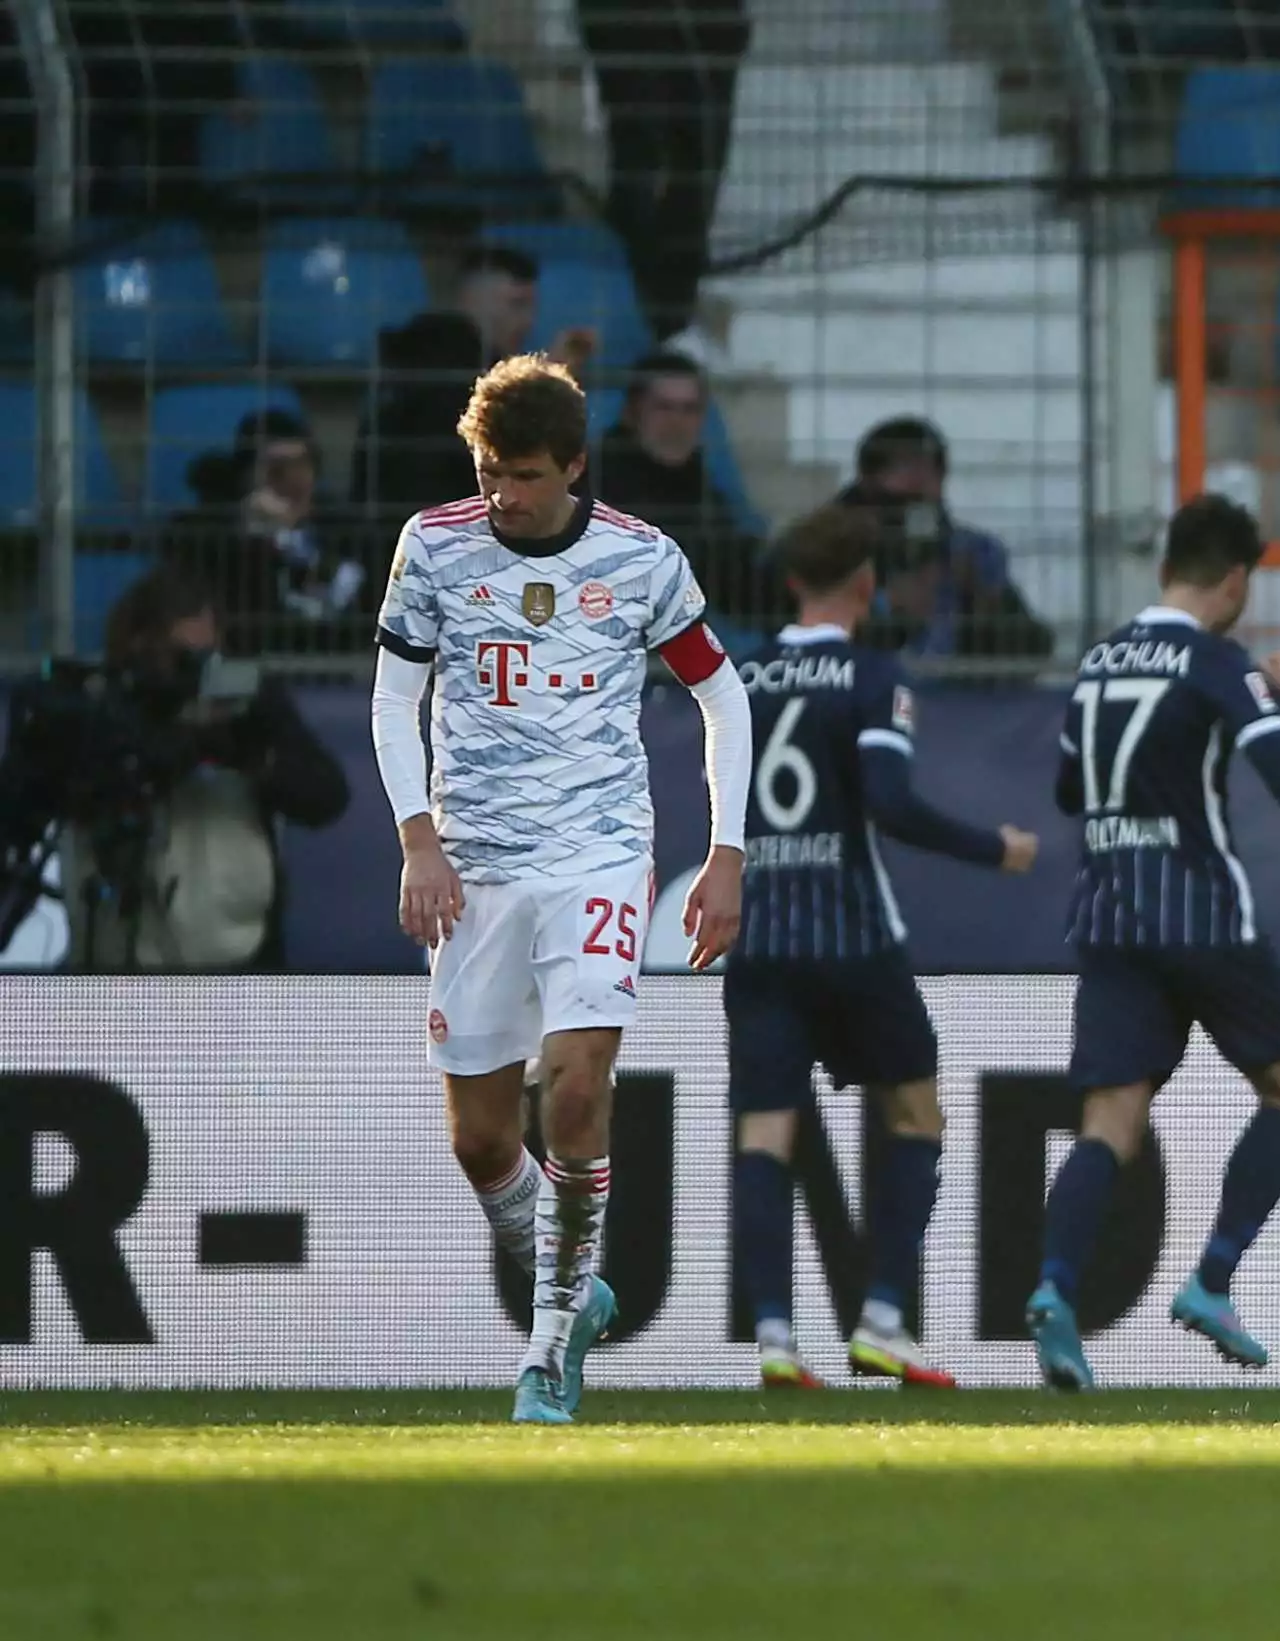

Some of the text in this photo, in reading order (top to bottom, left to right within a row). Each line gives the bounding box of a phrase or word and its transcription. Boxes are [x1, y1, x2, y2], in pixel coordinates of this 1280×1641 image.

[738, 654, 855, 695] OCHUM
[756, 696, 817, 831] 6
[1072, 677, 1174, 814] 17
[582, 897, 637, 962] 25
[492, 1069, 1166, 1344] UND
